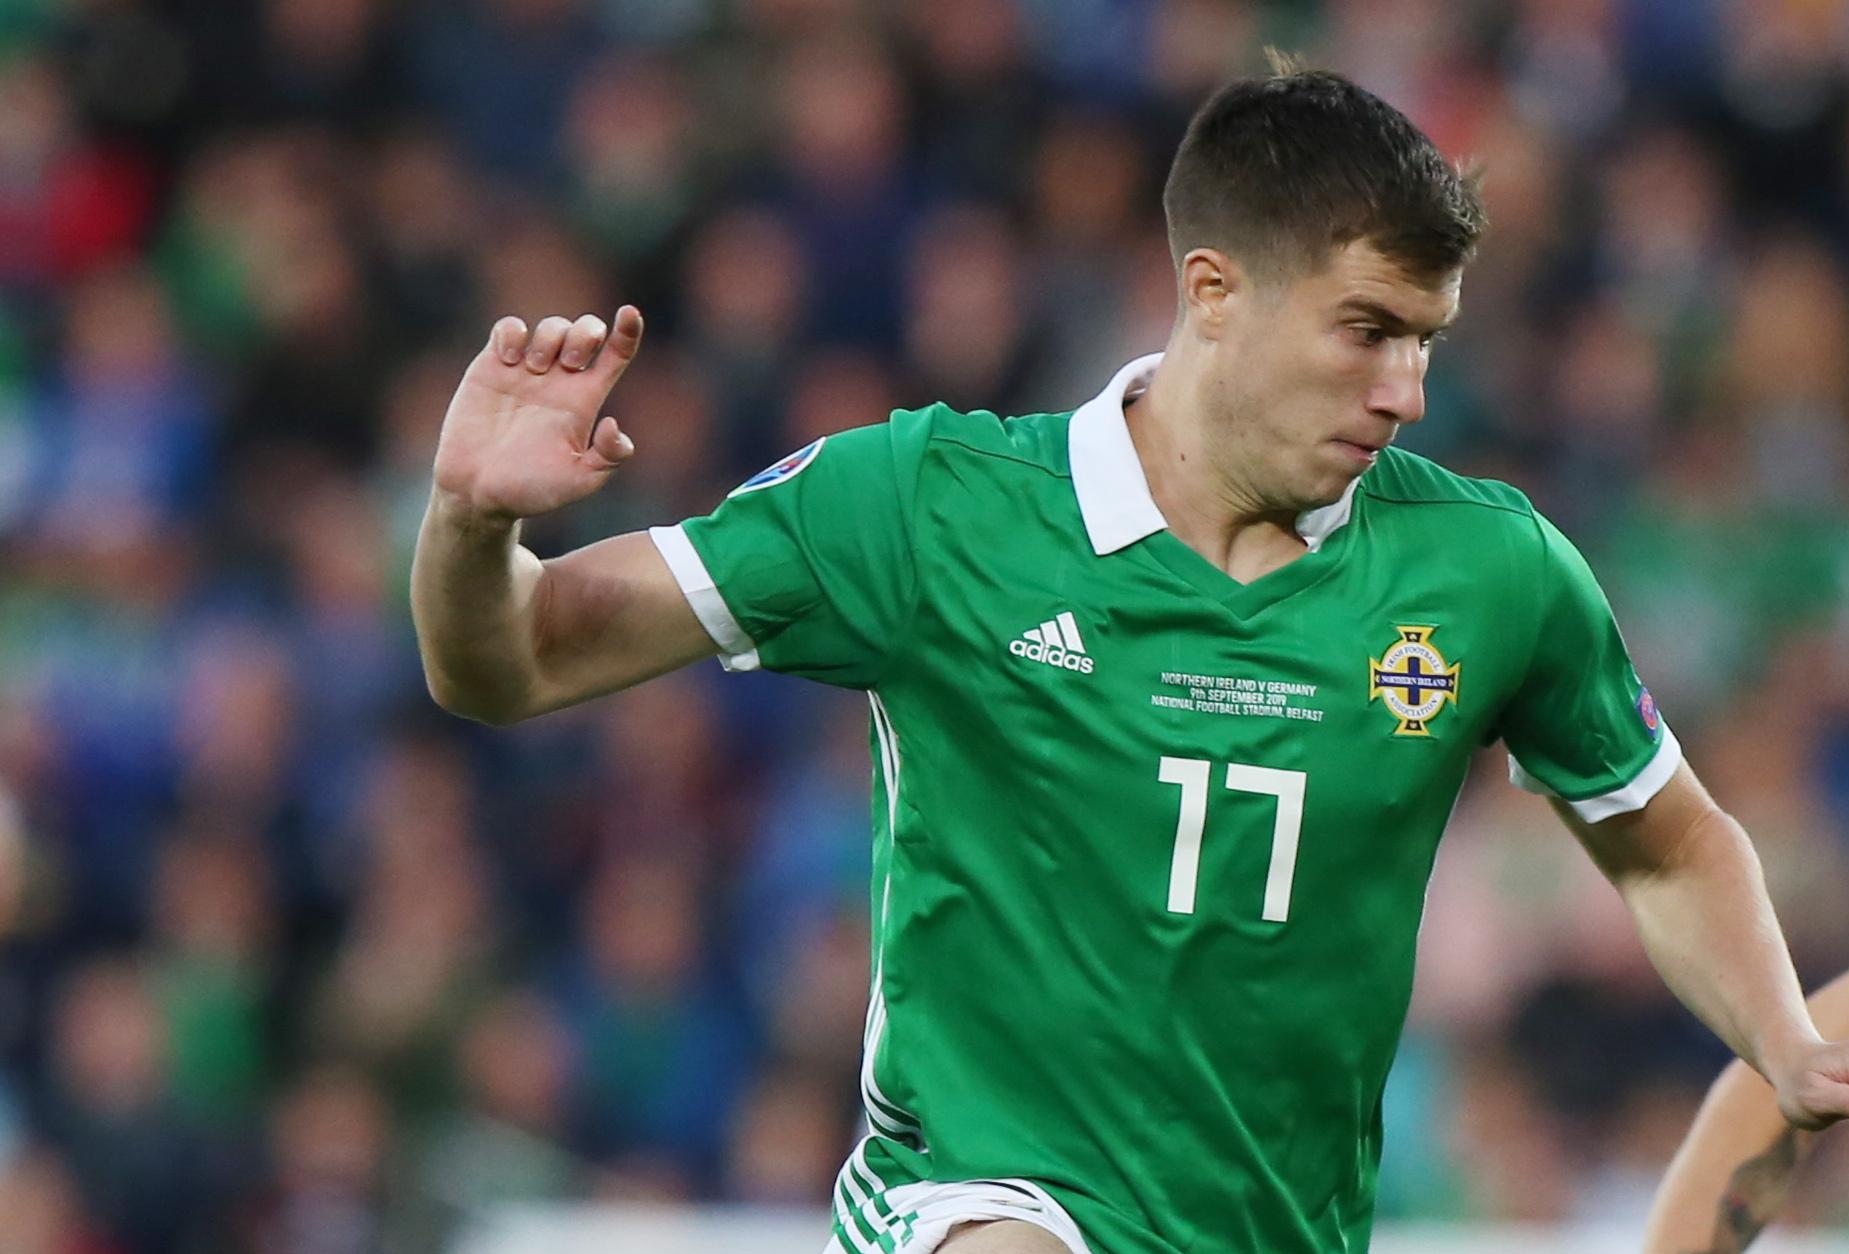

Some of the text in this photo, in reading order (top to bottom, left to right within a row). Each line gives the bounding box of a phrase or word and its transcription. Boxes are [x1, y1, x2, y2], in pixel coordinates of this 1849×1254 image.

[1009, 640, 1094, 674] adidas
[1161, 672, 1317, 697] NORTHERN IRELAND V GERMANY
[1190, 687, 1287, 706] 9th SEPTEMBER 2019
[1151, 694, 1194, 711] NATIONAL
[1196, 700, 1241, 715] FOOTBALL
[1286, 707, 1324, 722] BELFAST
[1158, 756, 1307, 923] 17
